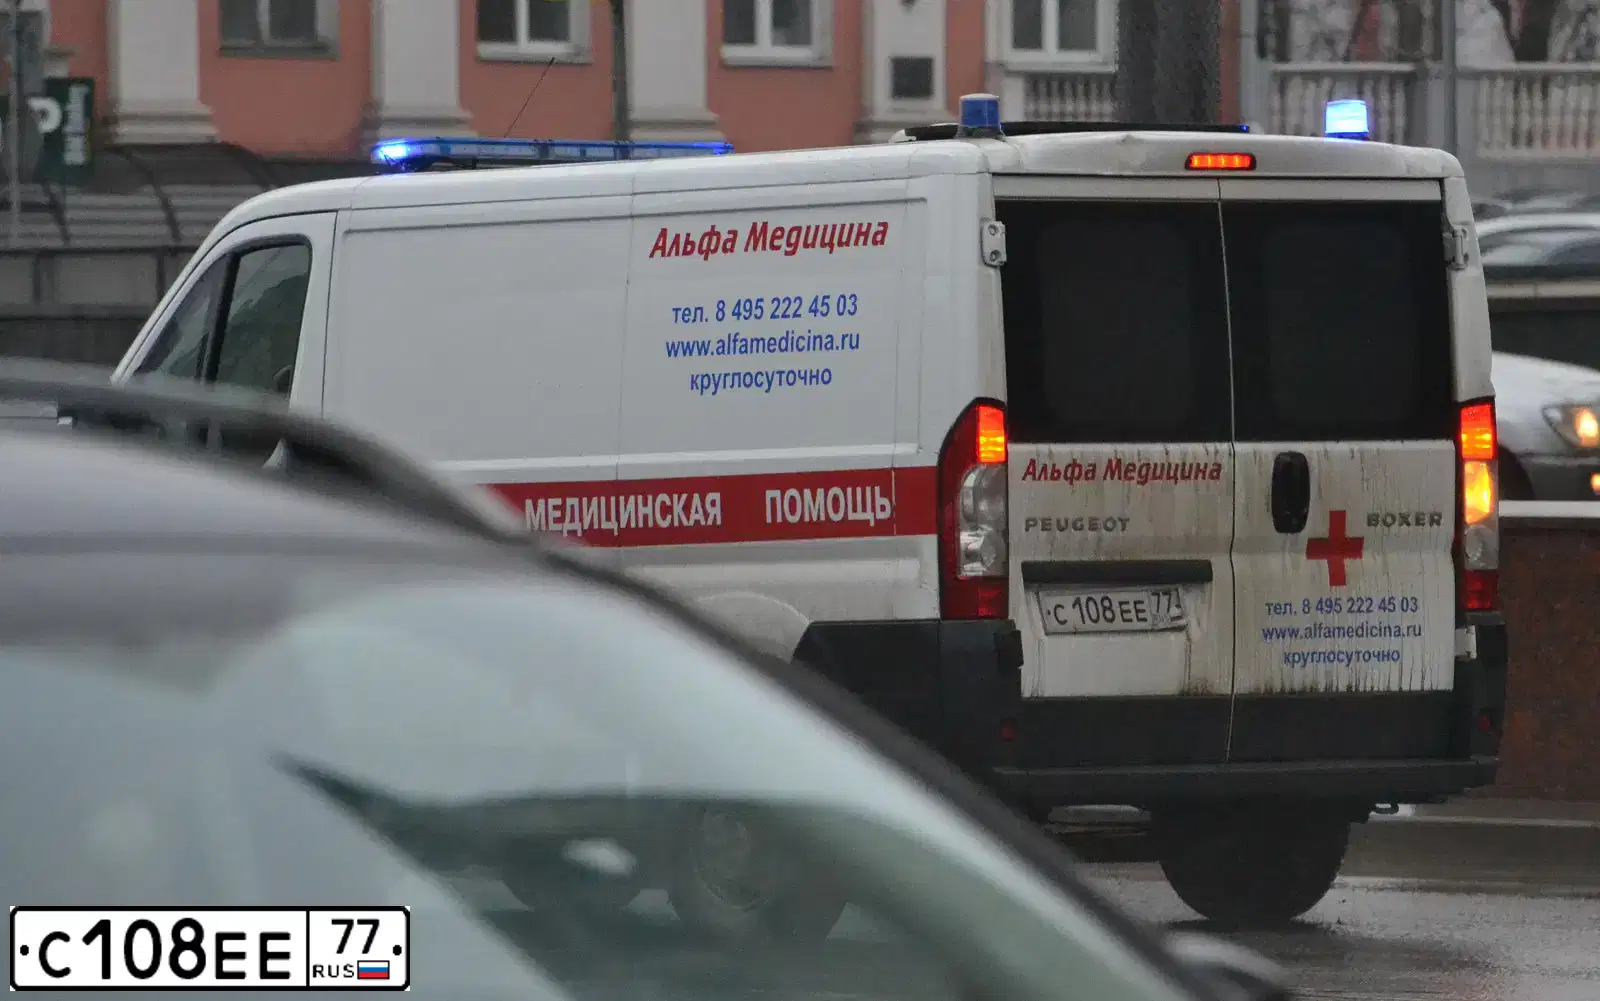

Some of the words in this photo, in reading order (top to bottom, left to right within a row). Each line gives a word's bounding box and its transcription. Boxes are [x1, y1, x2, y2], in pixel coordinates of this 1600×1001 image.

[649, 224, 739, 261] Альфа
[743, 221, 889, 256] Медицина
[672, 305, 709, 324] тел.
[715, 300, 726, 322] 8
[732, 298, 764, 321] 495
[770, 296, 802, 319] 222
[808, 295, 831, 318] 45
[836, 293, 858, 316] 03
[665, 329, 860, 358] www.alfamedicina.ru
[690, 367, 832, 395] круглосуточно
[1022, 458, 1097, 486] Альфа
[1103, 458, 1222, 486] Медицина
[525, 492, 722, 537] МЕДИЦИНСКАЯ
[765, 485, 893, 526] ПОМОЩЬ
[1366, 512, 1443, 528] BOXER
[1024, 516, 1130, 533] PEUGEOT
[1151, 591, 1172, 614] 77
[1265, 600, 1297, 616] тел.
[1302, 598, 1310, 615] 8
[1315, 597, 1343, 614] 495
[1346, 597, 1374, 613] 222
[1378, 596, 1396, 612] 45
[1400, 596, 1419, 613] 03
[1262, 620, 1422, 642] www.alfamedicina.ru
[1283, 649, 1401, 669] круглосуточно
